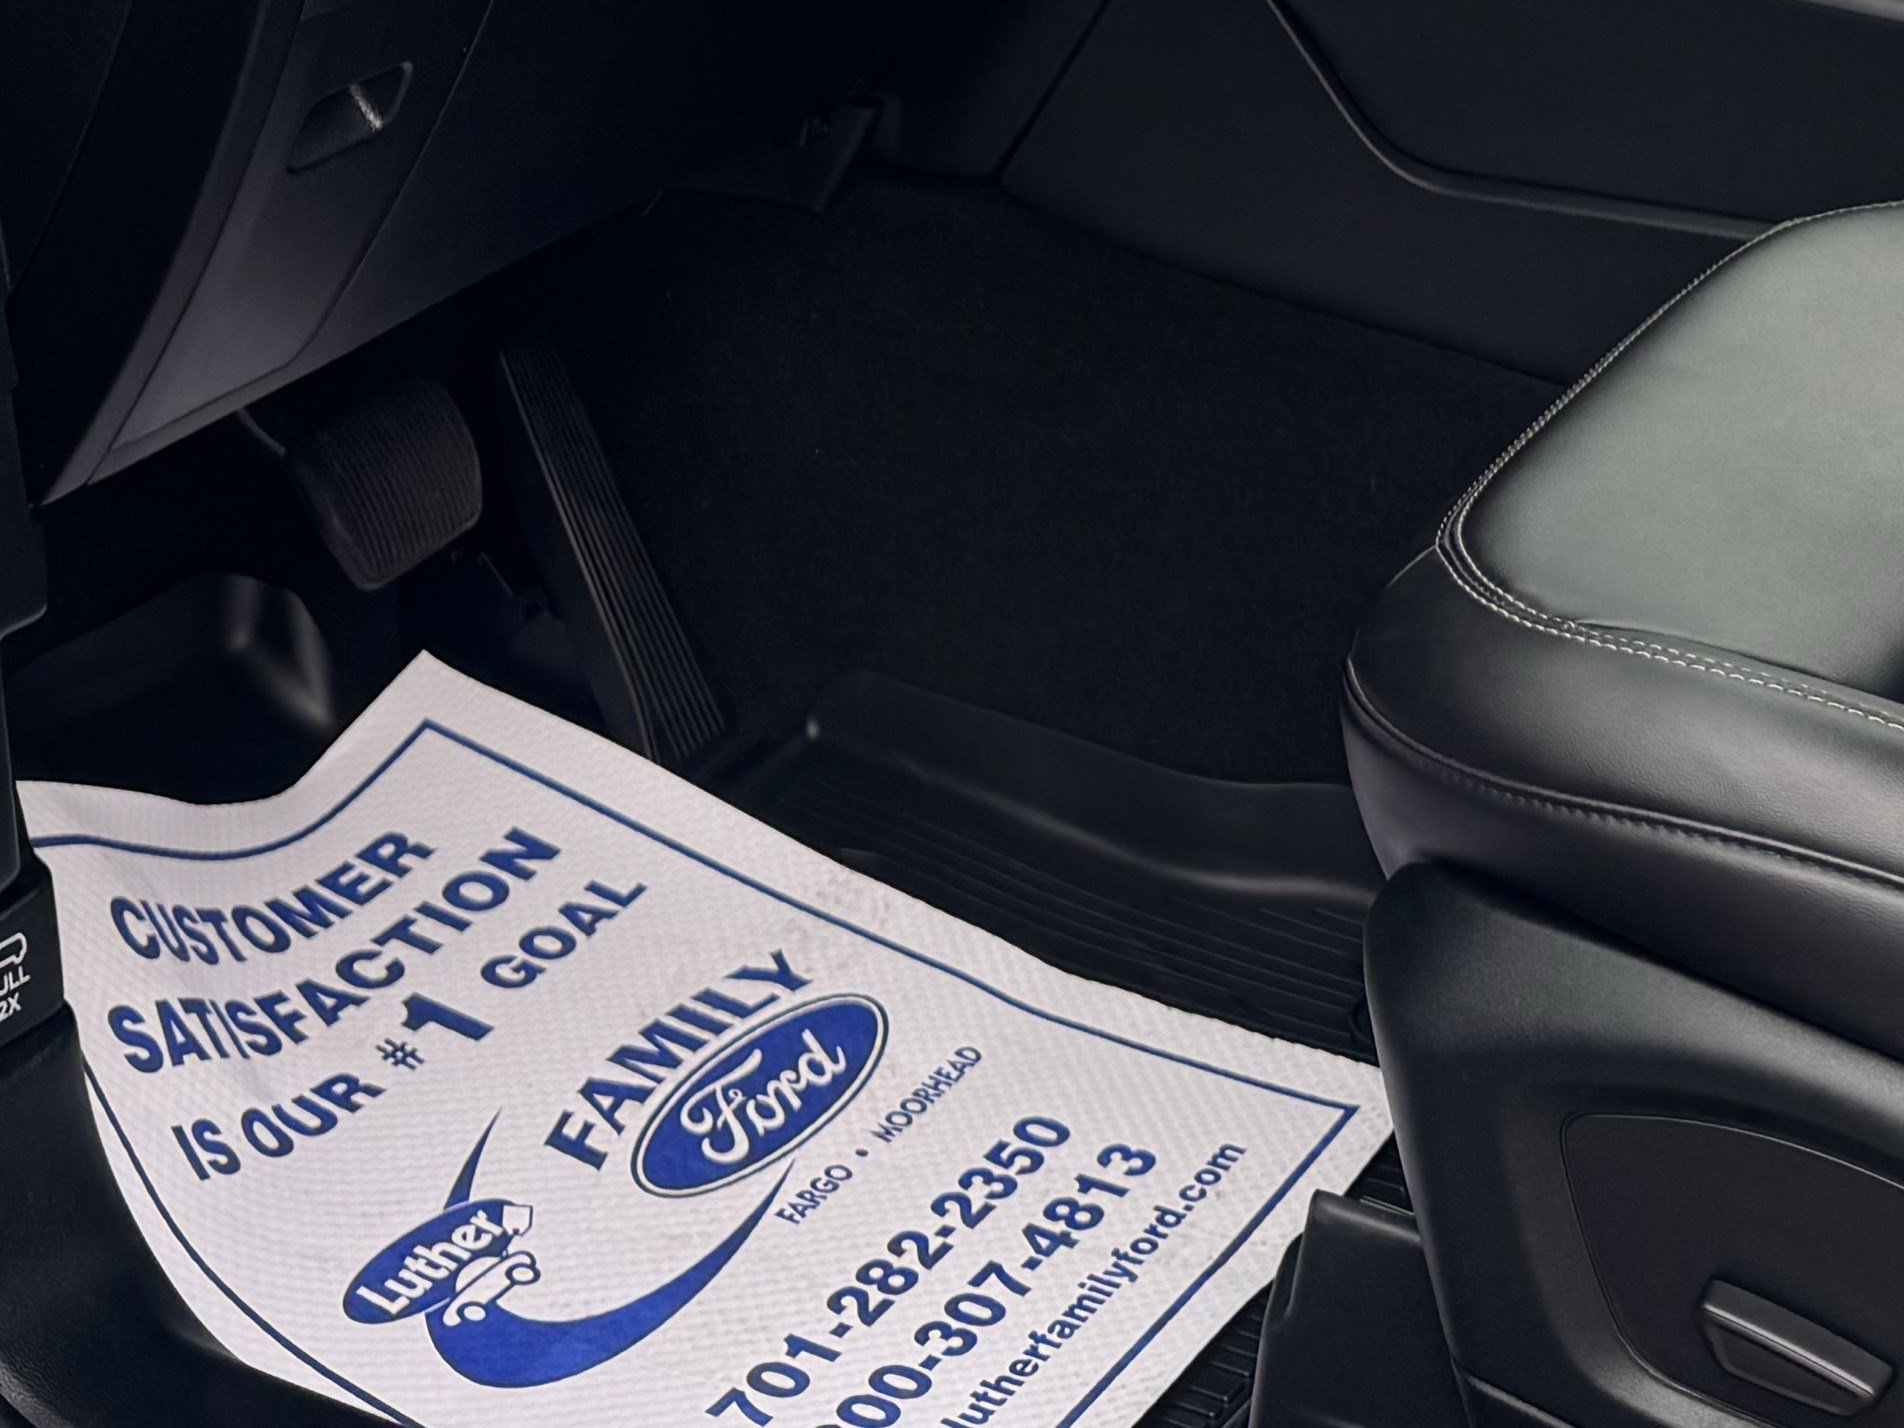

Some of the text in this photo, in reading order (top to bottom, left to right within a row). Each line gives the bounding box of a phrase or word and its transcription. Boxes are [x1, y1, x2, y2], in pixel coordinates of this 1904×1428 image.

[107, 825, 562, 1074] SATISFACTION
[109, 831, 437, 967] CUSTOMER
[171, 1118, 242, 1181] IS
[240, 1072, 387, 1158] OUR
[479, 879, 648, 990] GOAL
[544, 947, 814, 1171] FAMILY
[679, 1028, 848, 1164] Ford
[775, 1044, 984, 1226] FARGO MOORHEAD
[355, 1208, 505, 1316] Luther
[704, 1114, 1072, 1428] 701-282-2350
[812, 1141, 1159, 1428] 00-307-4813
